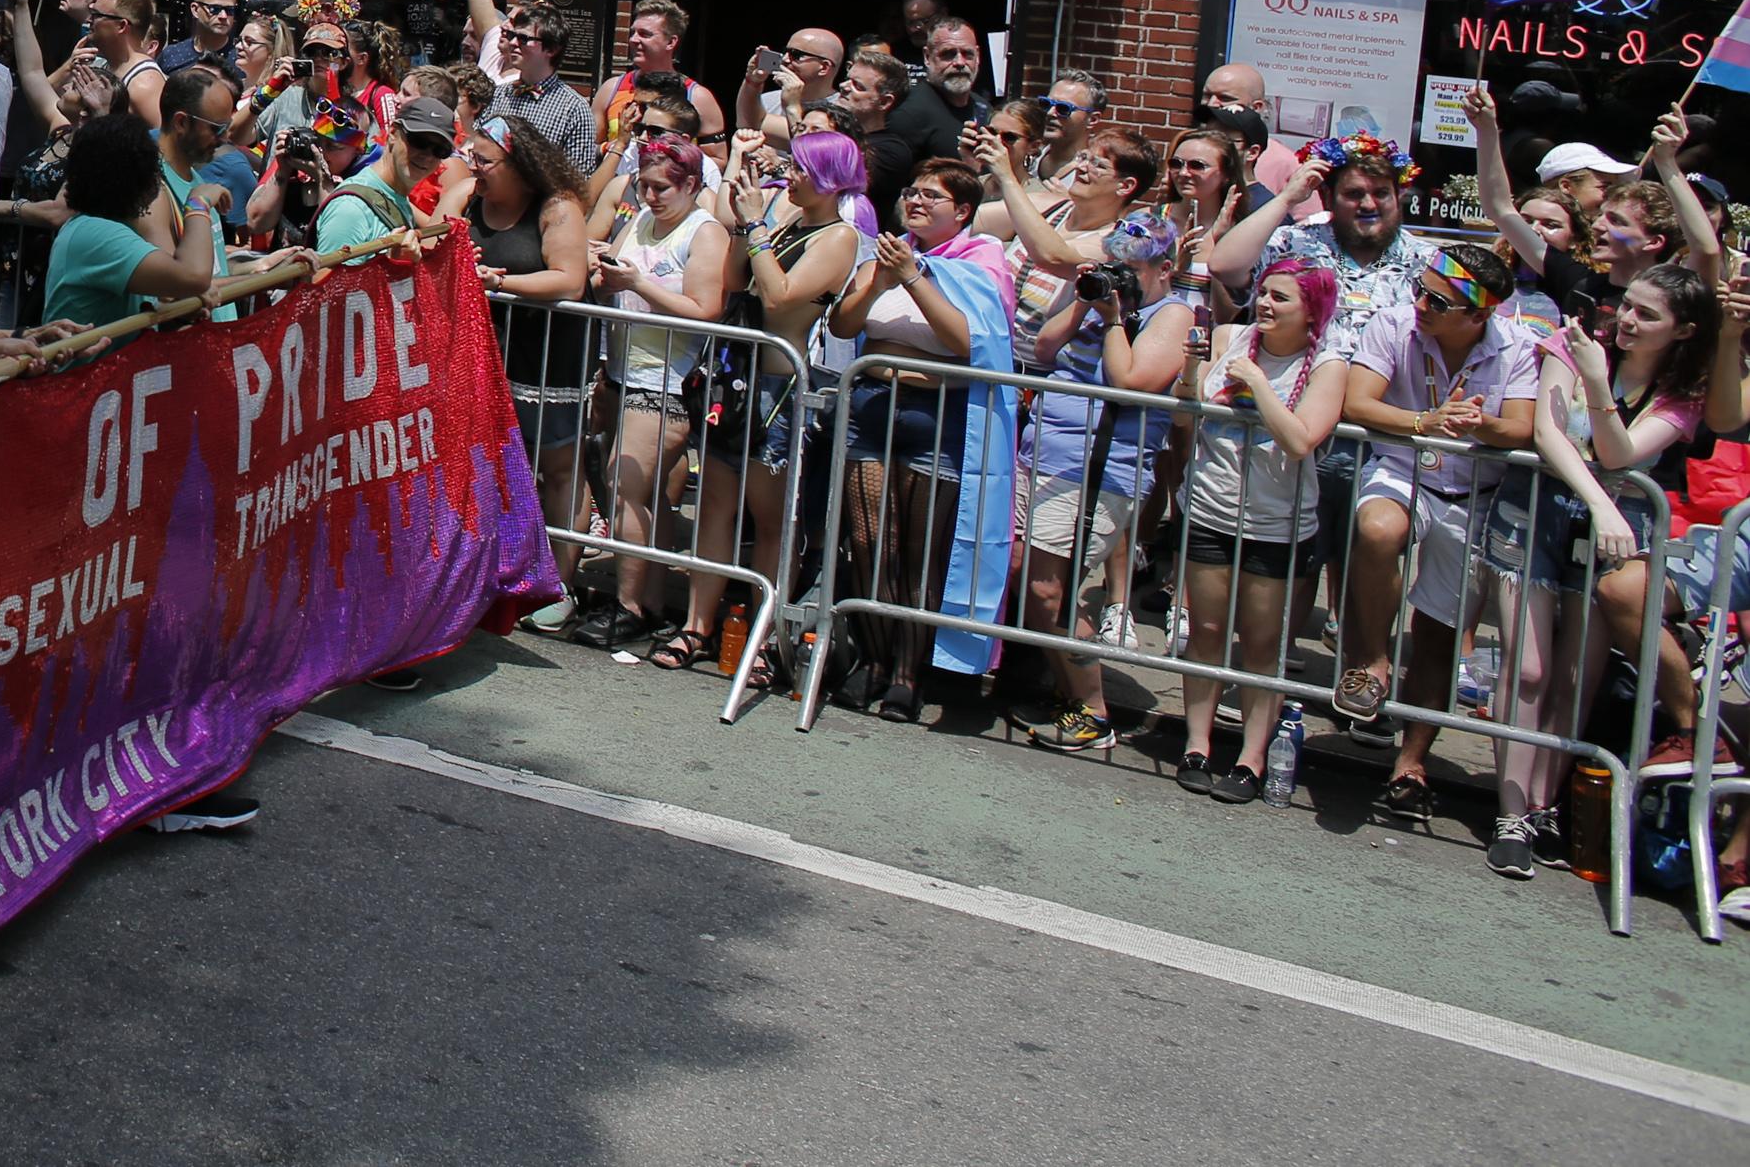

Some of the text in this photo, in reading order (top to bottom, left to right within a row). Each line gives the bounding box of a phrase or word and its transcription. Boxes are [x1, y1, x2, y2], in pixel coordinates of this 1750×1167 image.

[1313, 6, 1355, 20] NAILS
[1358, 10, 1369, 21] &
[1373, 11, 1400, 24] SPA
[1247, 24, 1260, 32] We
[1262, 26, 1276, 34] use
[1278, 28, 1327, 39] autoclaved
[1329, 32, 1354, 41] metal
[1458, 17, 1588, 59] NAILS
[1617, 29, 1647, 65] &
[1256, 37, 1300, 48] Disposable
[1302, 41, 1319, 50] foot
[1338, 45, 1356, 53] and
[1358, 47, 1395, 57] sanitized
[1257, 61, 1270, 69] We
[1306, 66, 1351, 77] disposable
[1353, 71, 1375, 80] sticks
[1377, 73, 1389, 81] for
[1335, 57, 1370, 67] services.
[1287, 76, 1317, 86] waxing
[1410, 195, 1487, 221] & Pedicu
[79, 364, 174, 529] OF
[232, 277, 430, 476] PRIDE
[235, 407, 440, 561] TRANSGENDER
[81, 709, 181, 814] CITY
